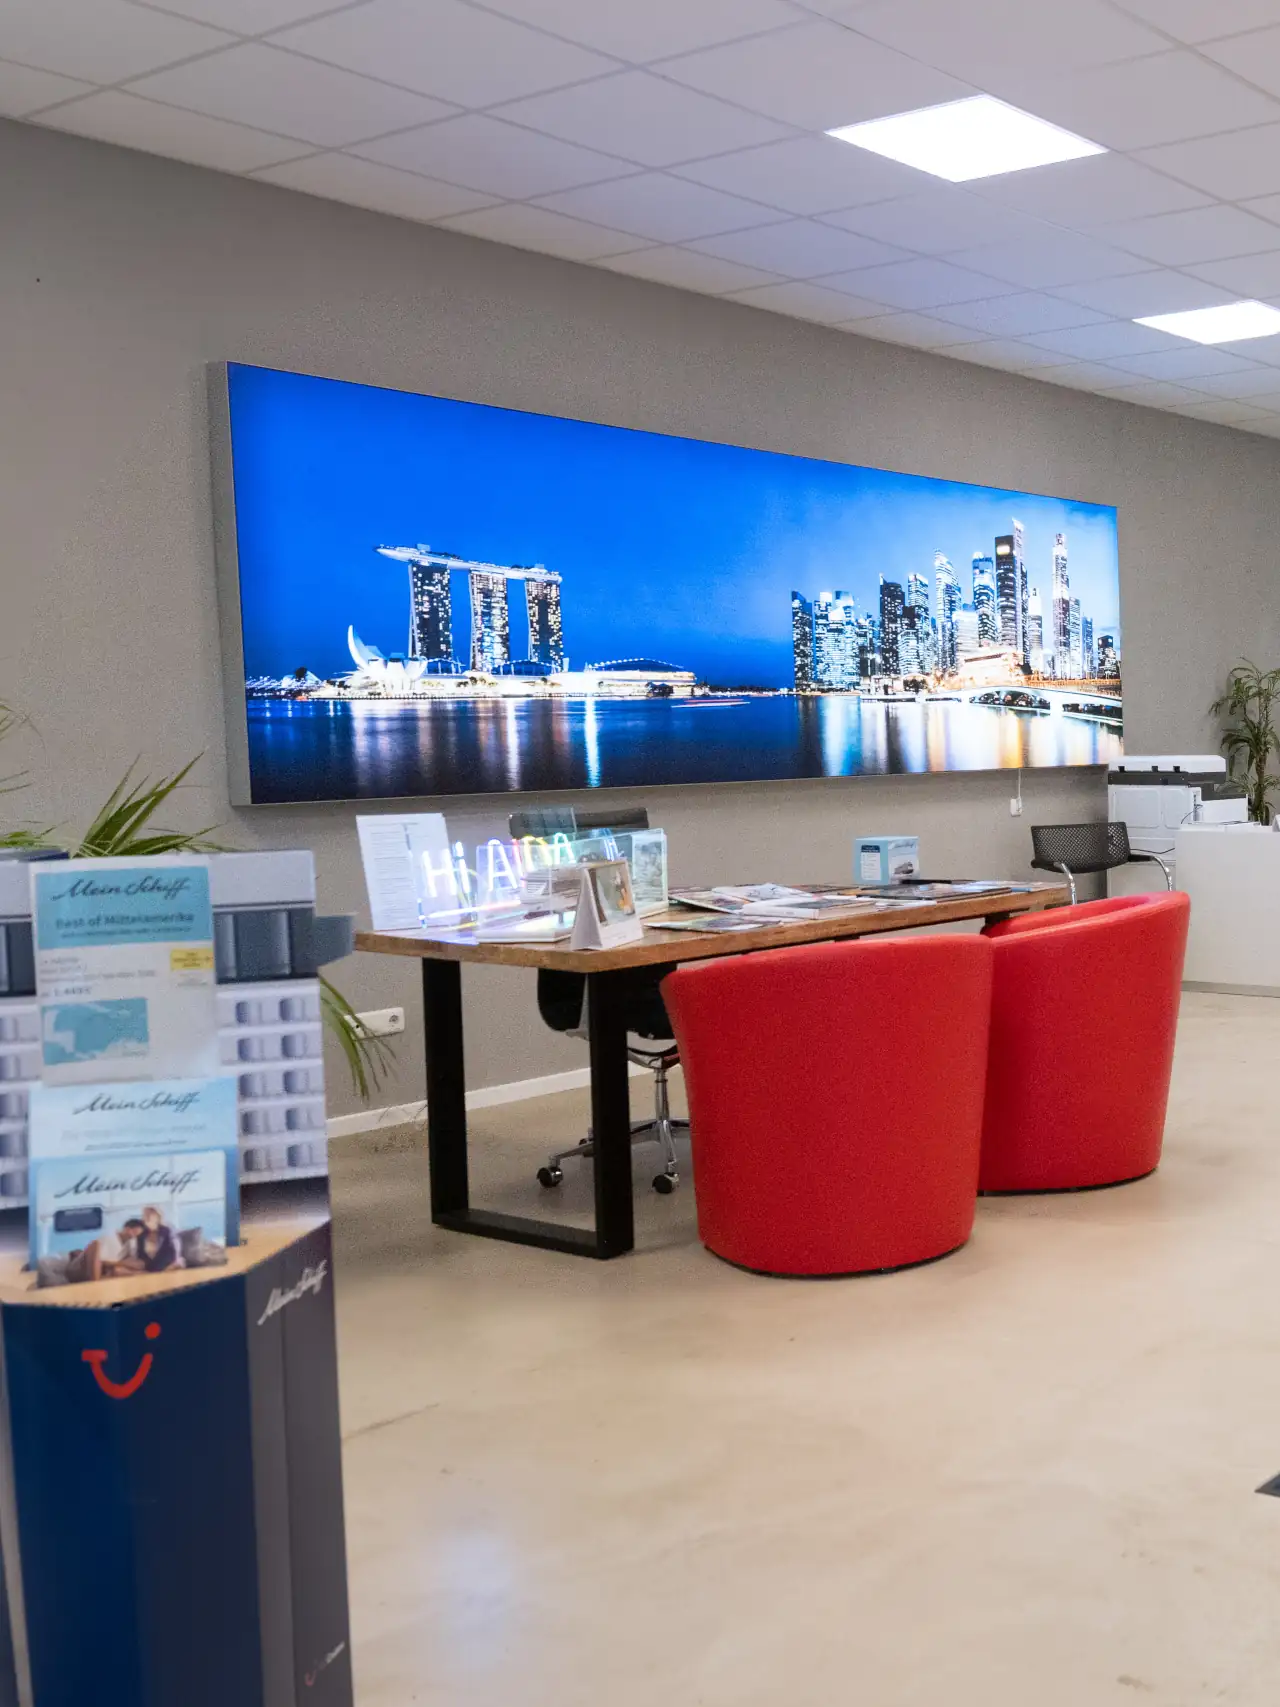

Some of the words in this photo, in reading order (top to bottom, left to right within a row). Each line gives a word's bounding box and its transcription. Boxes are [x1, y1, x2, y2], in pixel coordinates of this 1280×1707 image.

[51, 878, 122, 901] Mein
[123, 875, 191, 900] Schiff
[72, 1092, 137, 1115] Mein
[138, 1090, 201, 1113] Schiff
[54, 1171, 128, 1198] Mein
[130, 1169, 200, 1196] Schiff
